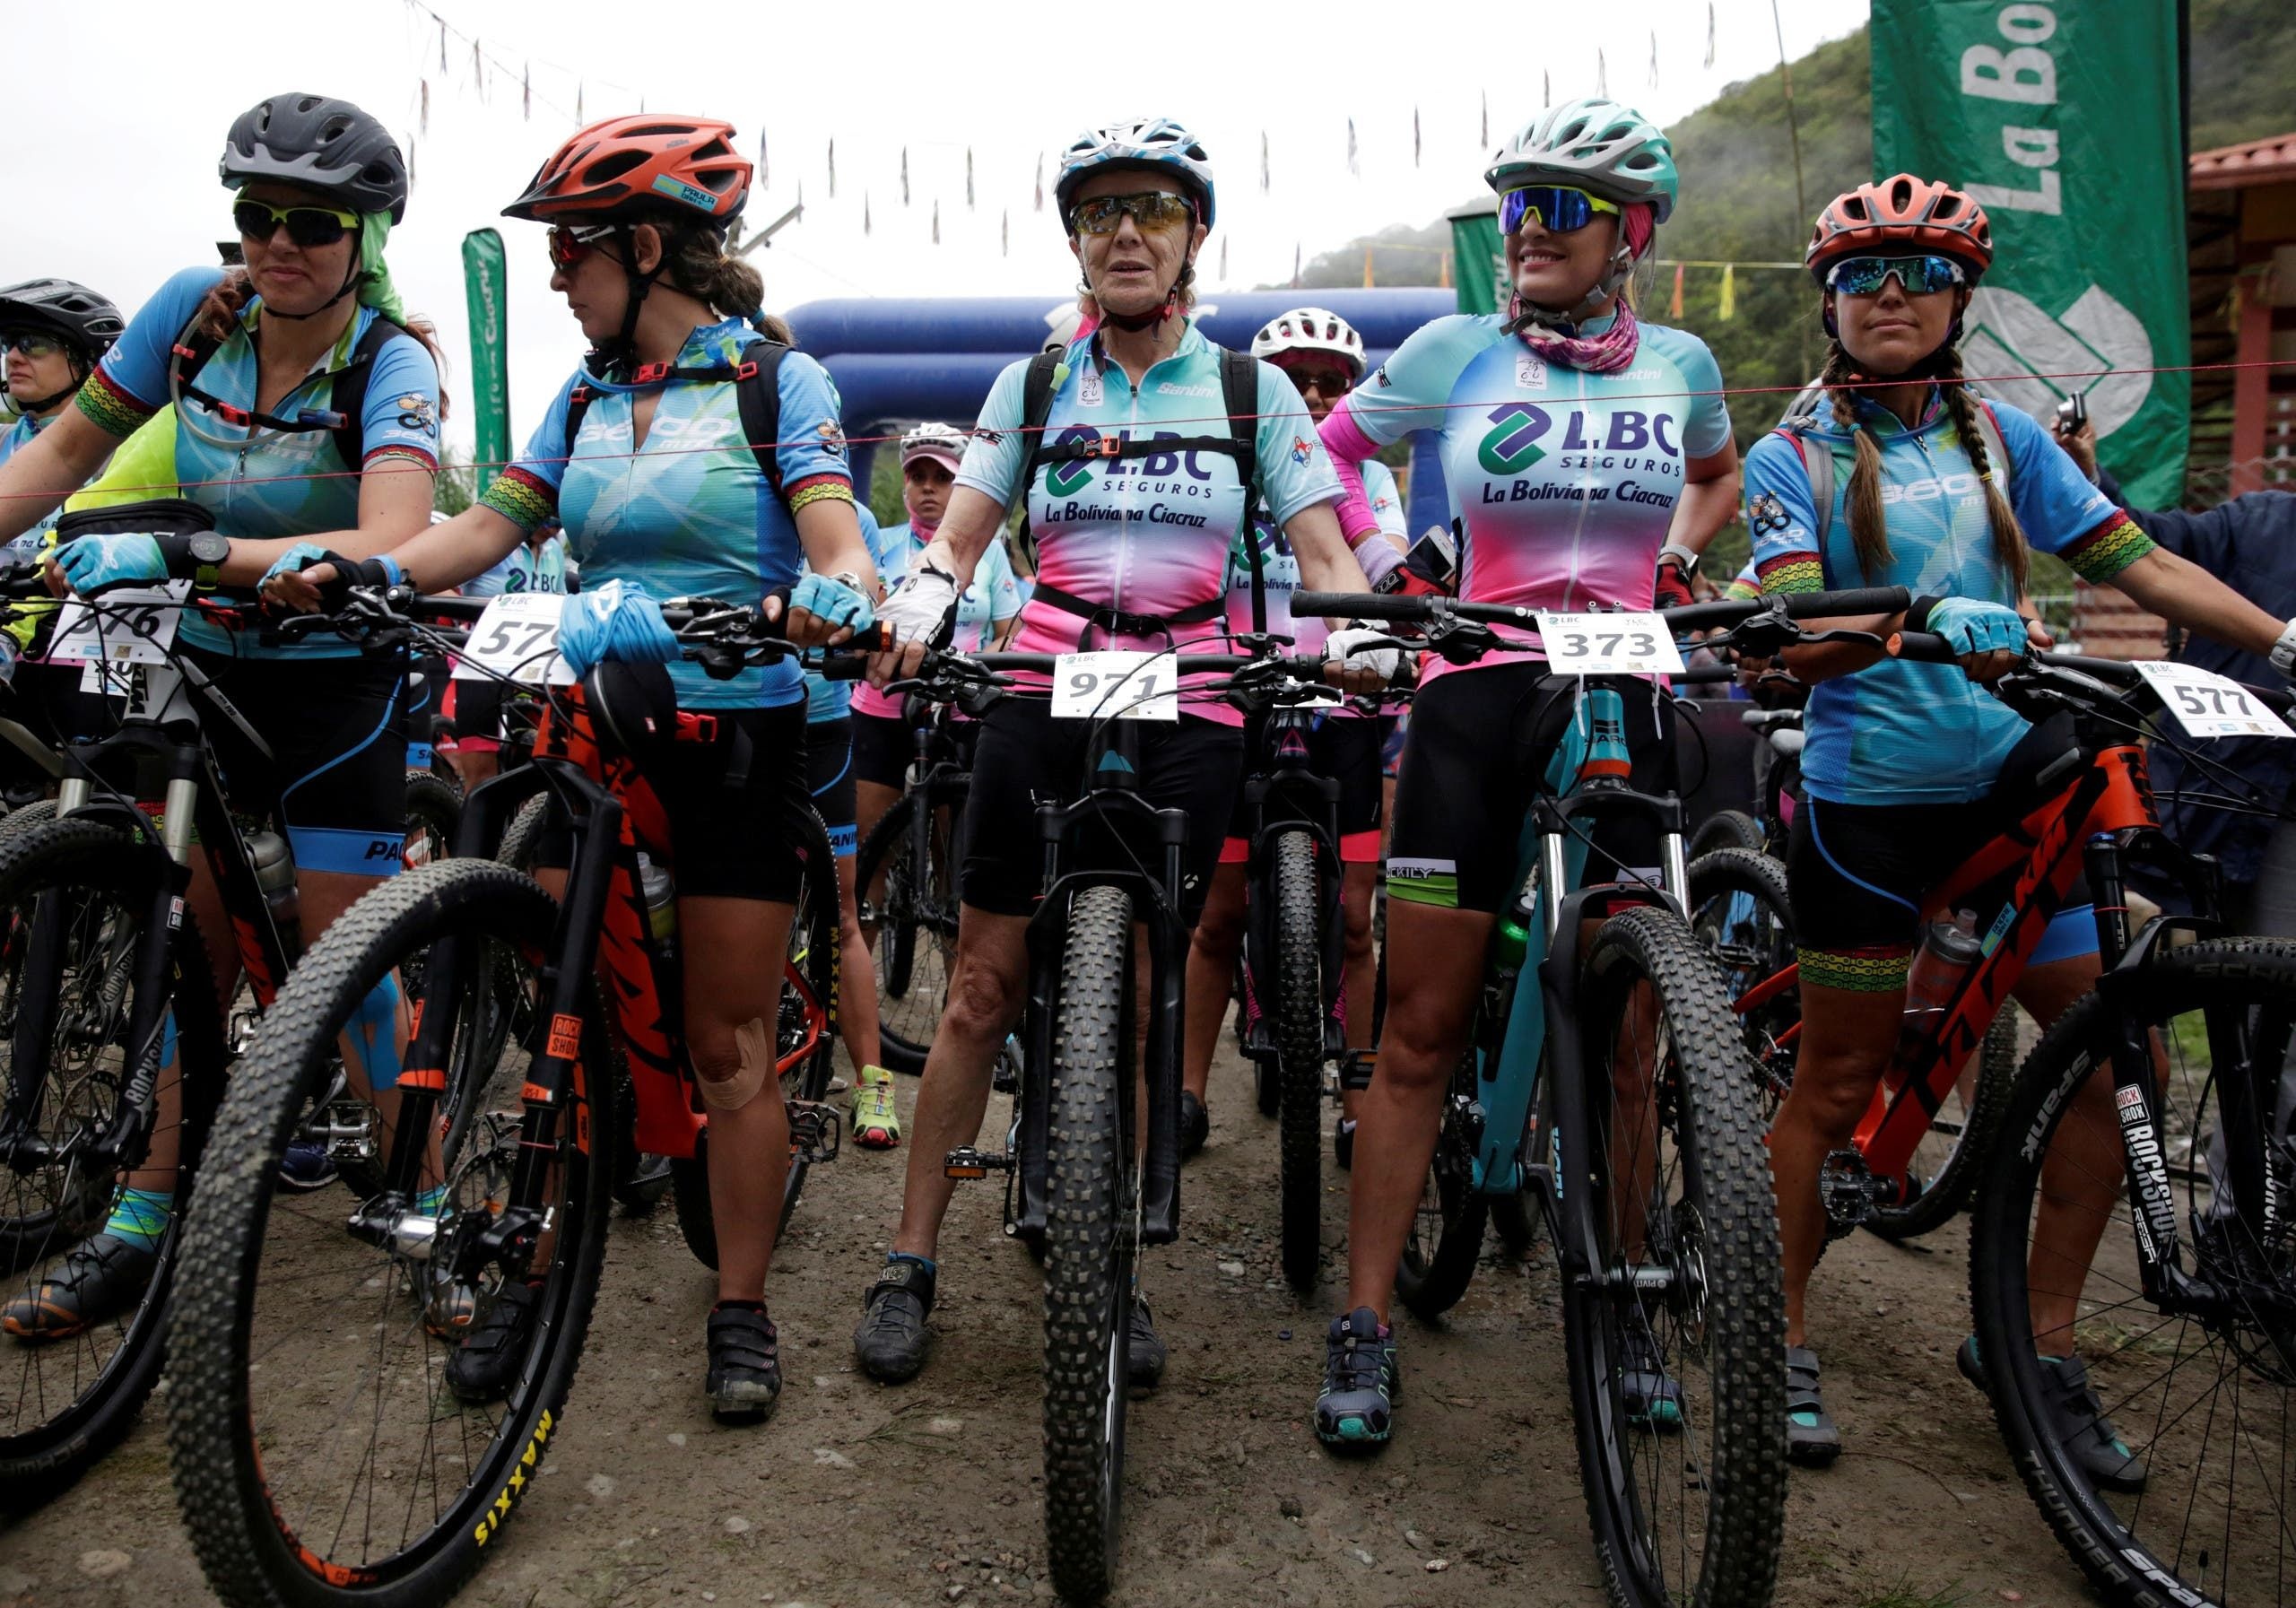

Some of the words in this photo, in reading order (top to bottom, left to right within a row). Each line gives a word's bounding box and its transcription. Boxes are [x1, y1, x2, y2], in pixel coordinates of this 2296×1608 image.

[1961, 4, 2057, 105] Bo
[1963, 125, 2061, 215] La
[1156, 382, 1215, 398] Santini
[1561, 411, 1679, 457] LBC
[1104, 430, 1212, 481] LBC
[1560, 456, 1680, 477] SEGUROS
[1102, 481, 1213, 499] SEGUROS
[1483, 482, 1506, 504] La
[1510, 479, 1611, 502] Boliviana
[1615, 480, 1674, 508] Ciacruz
[1045, 503, 1060, 523] La
[1065, 501, 1144, 522] Boliviana
[1149, 502, 1207, 528] Ciacruz
[530, 571, 556, 593] LBC
[1236, 576, 1249, 589] La
[510, 596, 534, 606] LBC
[69, 601, 161, 638] 576
[1561, 633, 1657, 657] 373
[1069, 673, 1158, 700] 971
[2173, 685, 2253, 717] 577
[828, 926, 841, 1022] MAXXIS
[2116, 1088, 2139, 1107] ROCK
[2119, 1105, 2145, 1124] SHOX
[474, 1407, 553, 1548] MAXXIS
[2023, 1448, 2130, 1585] THUNDER
